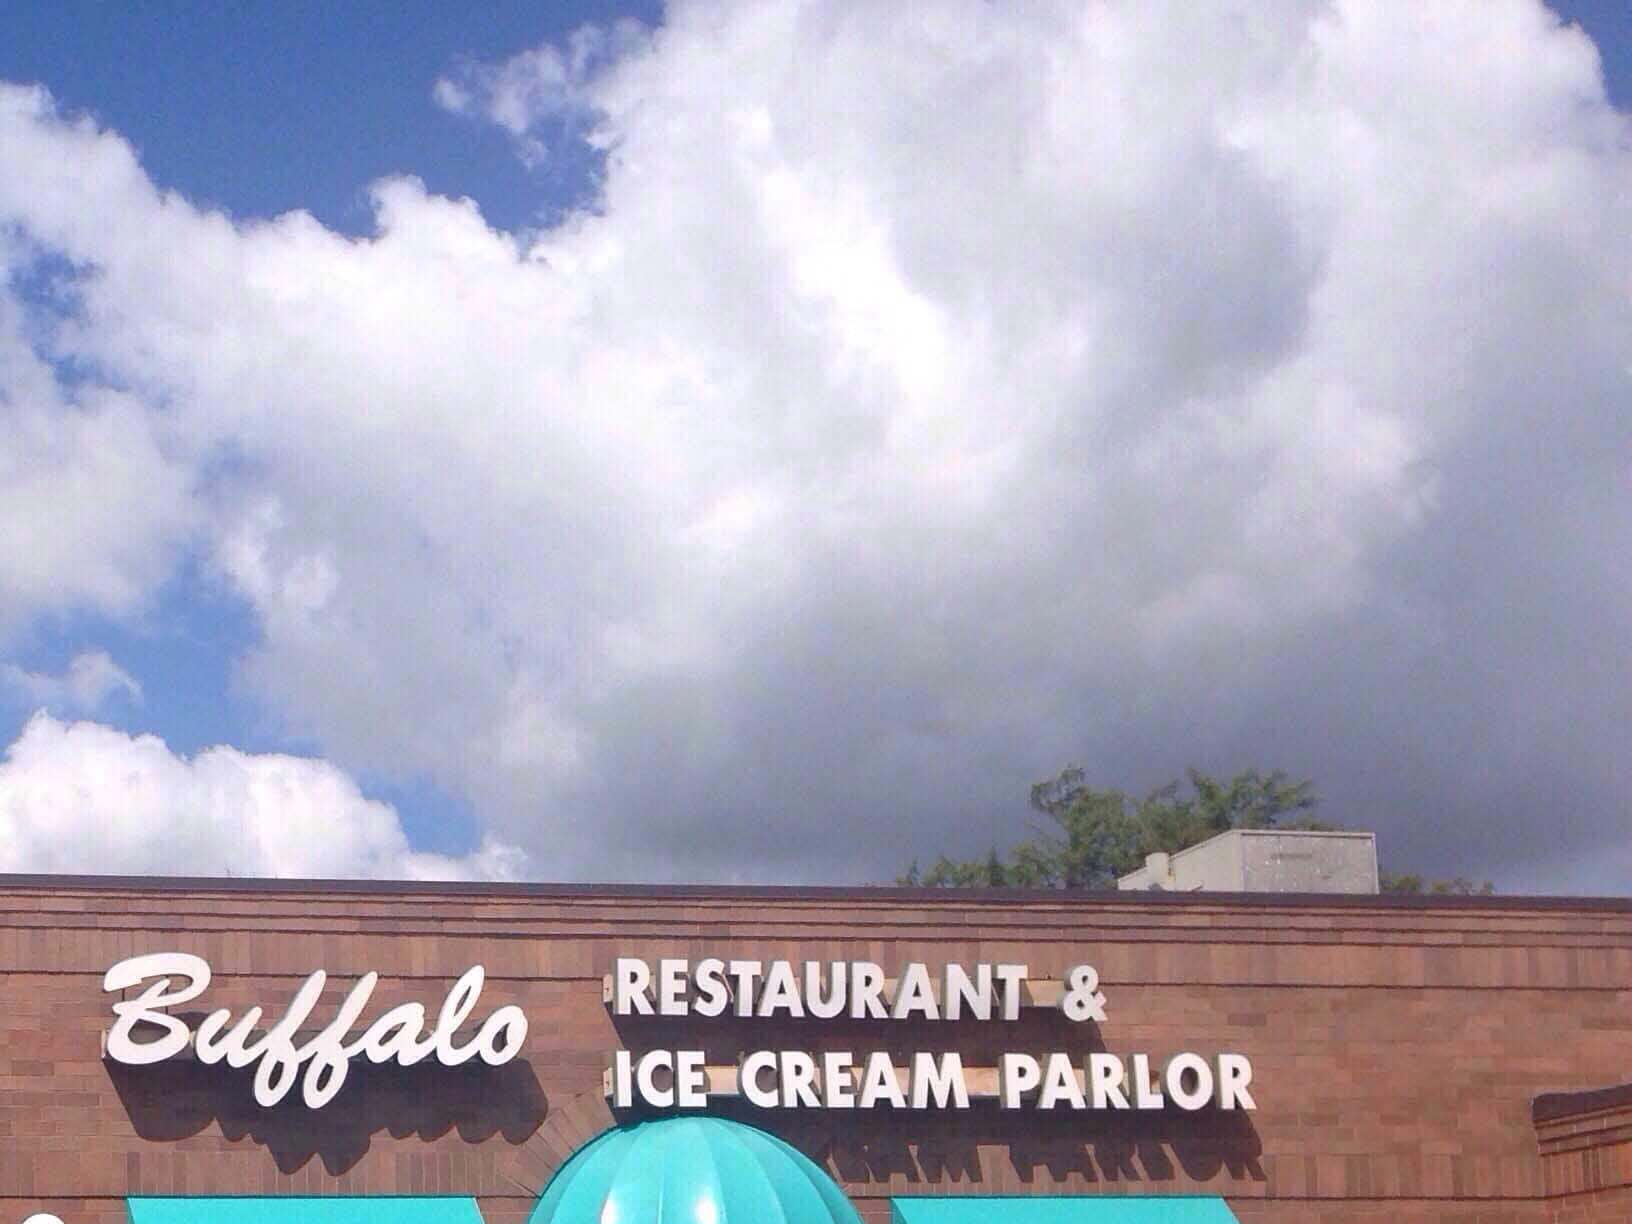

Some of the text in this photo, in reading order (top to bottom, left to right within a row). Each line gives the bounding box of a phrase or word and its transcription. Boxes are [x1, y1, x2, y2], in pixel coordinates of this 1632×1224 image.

[615, 956, 1109, 1023] RESTAURANT &
[101, 950, 530, 1110] Buffalo
[614, 1049, 1257, 1111] ICE CREAM PARLOR
